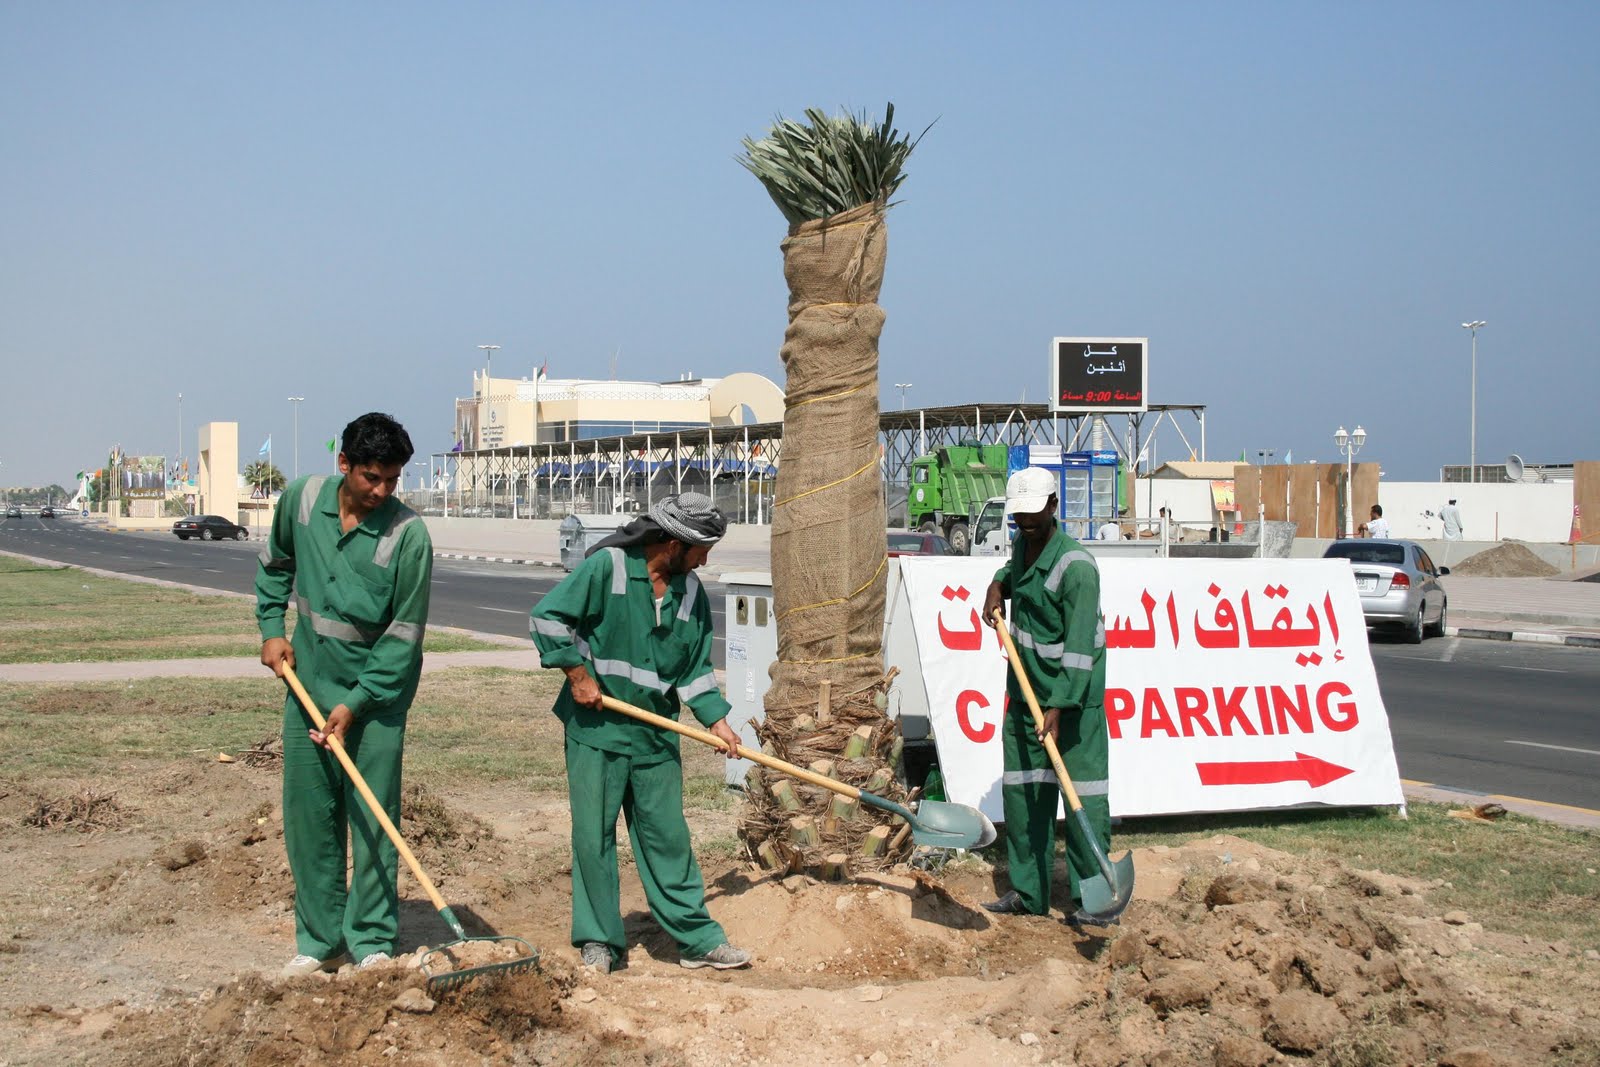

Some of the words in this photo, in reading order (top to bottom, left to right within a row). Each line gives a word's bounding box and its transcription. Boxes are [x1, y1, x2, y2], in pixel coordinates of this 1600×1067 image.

[1084, 345, 1117, 357] كل
[1086, 391, 1112, 402] 9:00
[1194, 582, 1345, 668] إيقاف
[1103, 680, 1361, 740] PARKING
